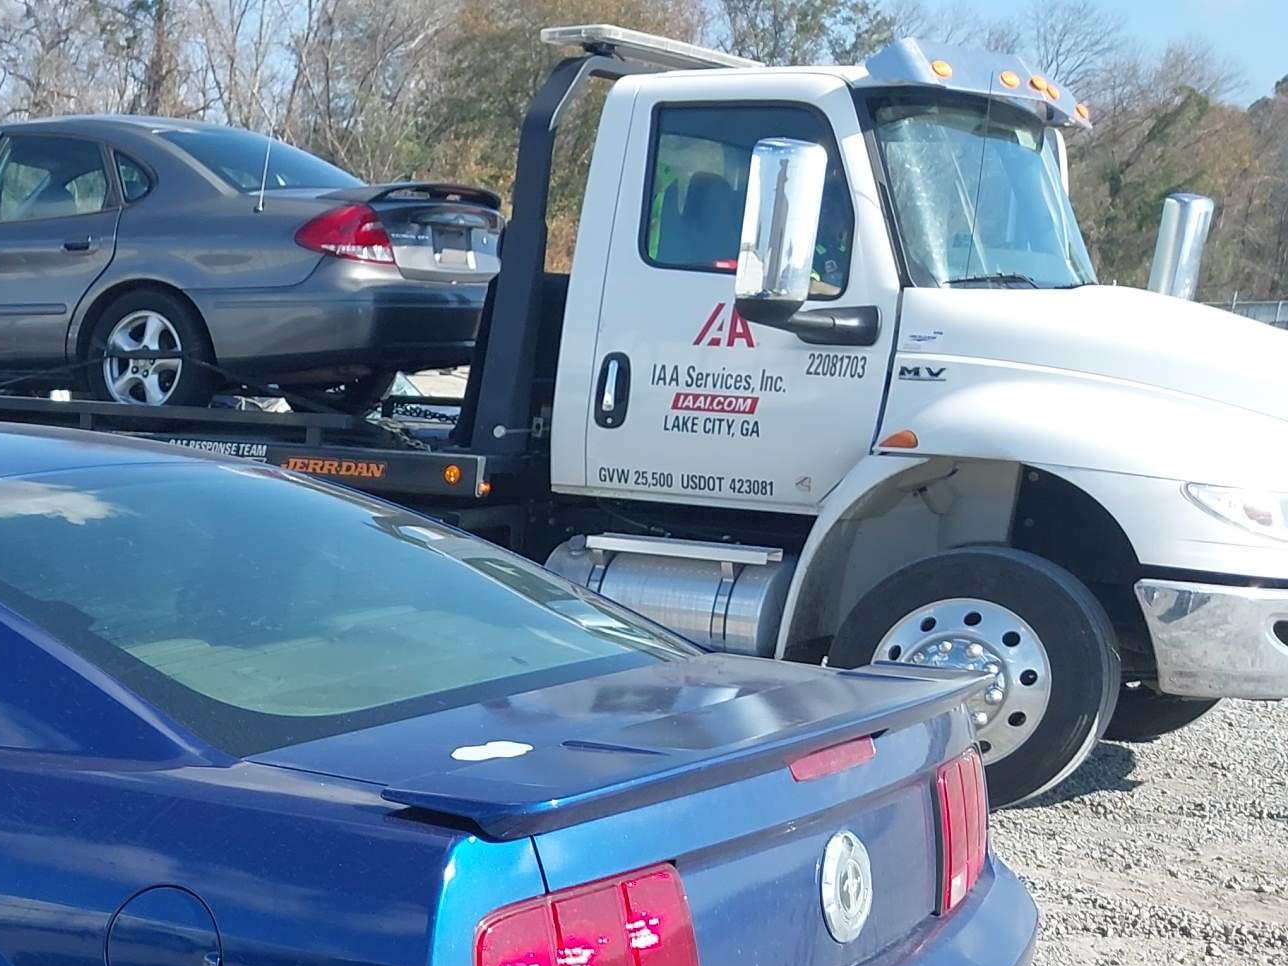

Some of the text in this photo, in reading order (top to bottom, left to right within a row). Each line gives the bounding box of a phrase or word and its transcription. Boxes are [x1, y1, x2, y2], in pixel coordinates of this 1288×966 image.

[806, 353, 867, 379] 22081703
[899, 366, 946, 378] MV
[651, 363, 787, 394] IAA Services, Inc.
[678, 394, 752, 412] IAAI.COM
[664, 415, 760, 438] LAKE CITY, GA
[238, 443, 268, 457] TEAM
[598, 466, 630, 484] GVW
[634, 470, 674, 489] 25,500
[680, 473, 725, 493] USDOT
[728, 477, 774, 497] 423081
